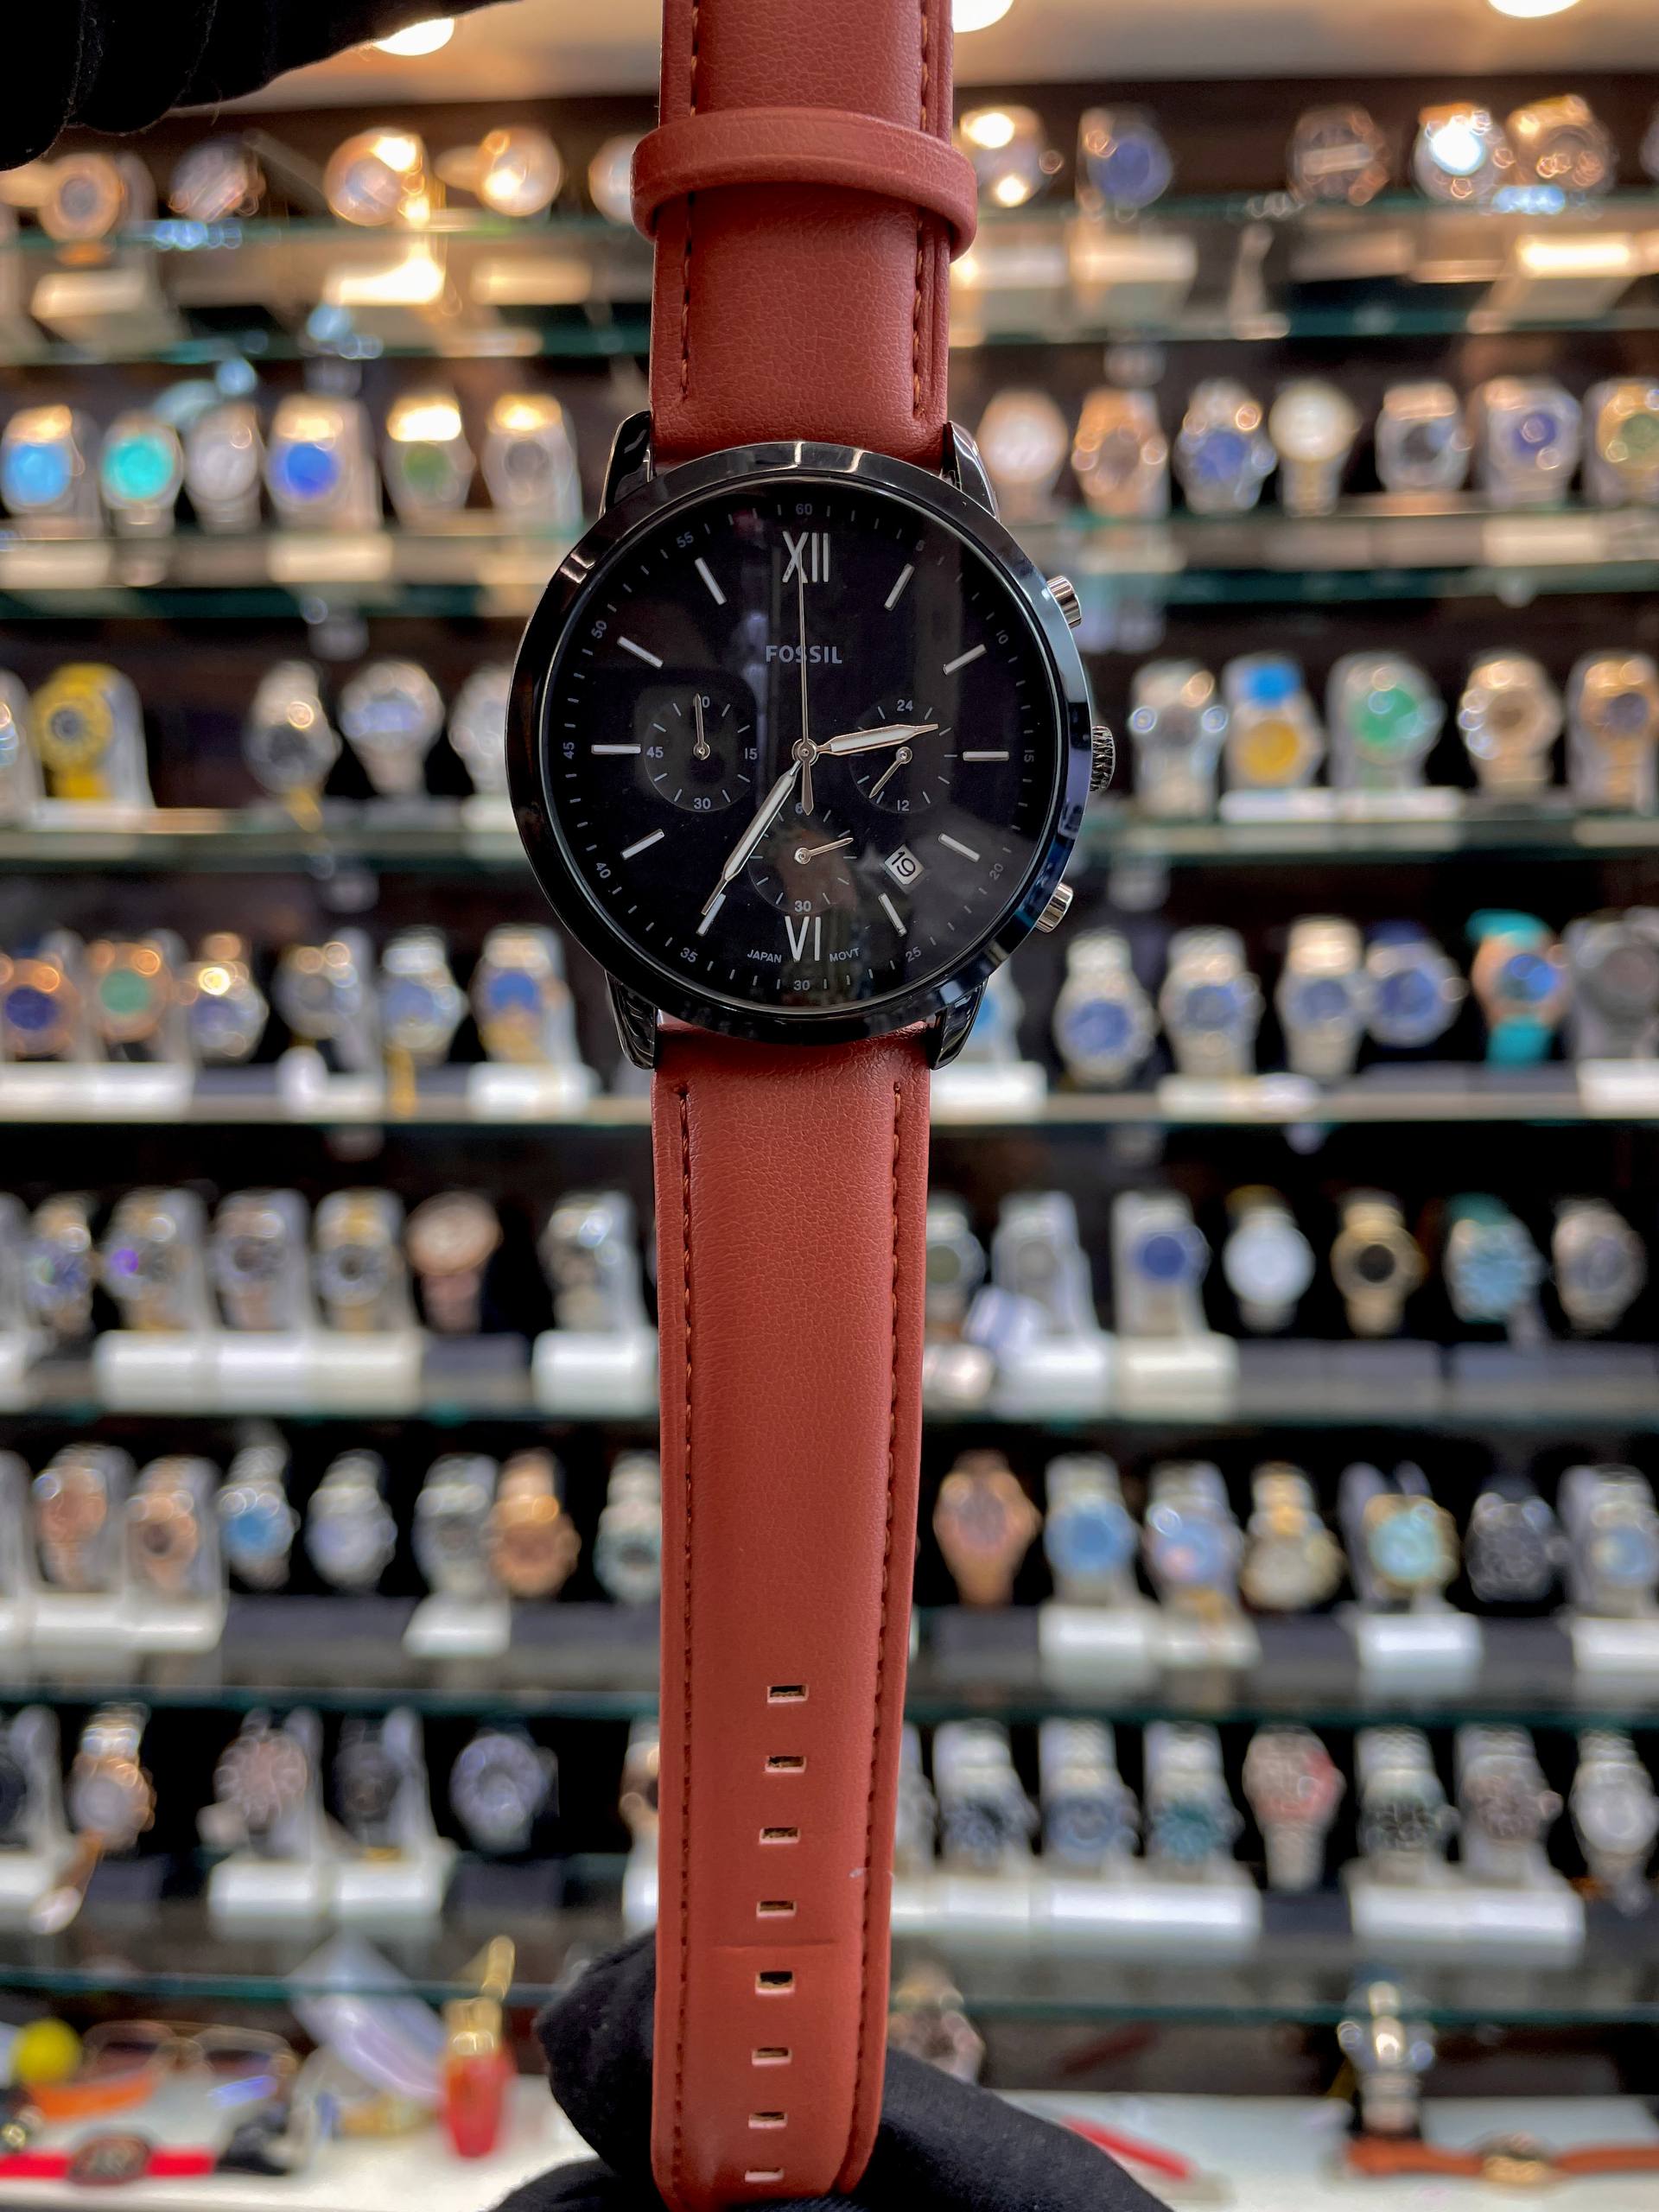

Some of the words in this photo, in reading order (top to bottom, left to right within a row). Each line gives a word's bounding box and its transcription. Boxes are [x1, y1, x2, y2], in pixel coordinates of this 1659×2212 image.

[796, 503, 813, 515] 60
[676, 531, 695, 549] 55
[782, 531, 830, 583] XII
[591, 620, 607, 639] 50
[995, 629, 1009, 645] 10
[766, 645, 842, 664] FOSSIL
[693, 696, 710, 709] 0
[896, 699, 913, 712] 24
[563, 741, 575, 760] 45
[646, 746, 664, 759] 45
[744, 747, 758, 760] 15
[1024, 749, 1035, 763] 15
[693, 798, 711, 810] 30
[896, 799, 910, 812] 12
[594, 861, 612, 880] 40
[890, 849, 917, 878] 19
[989, 863, 1003, 880] 20
[794, 899, 812, 912] 30
[785, 915, 822, 963] VI
[679, 947, 698, 963] 35
[747, 949, 782, 963] JAPAN
[829, 946, 861, 963] MOVT
[905, 946, 922, 963] 25
[793, 979, 811, 992] 30
